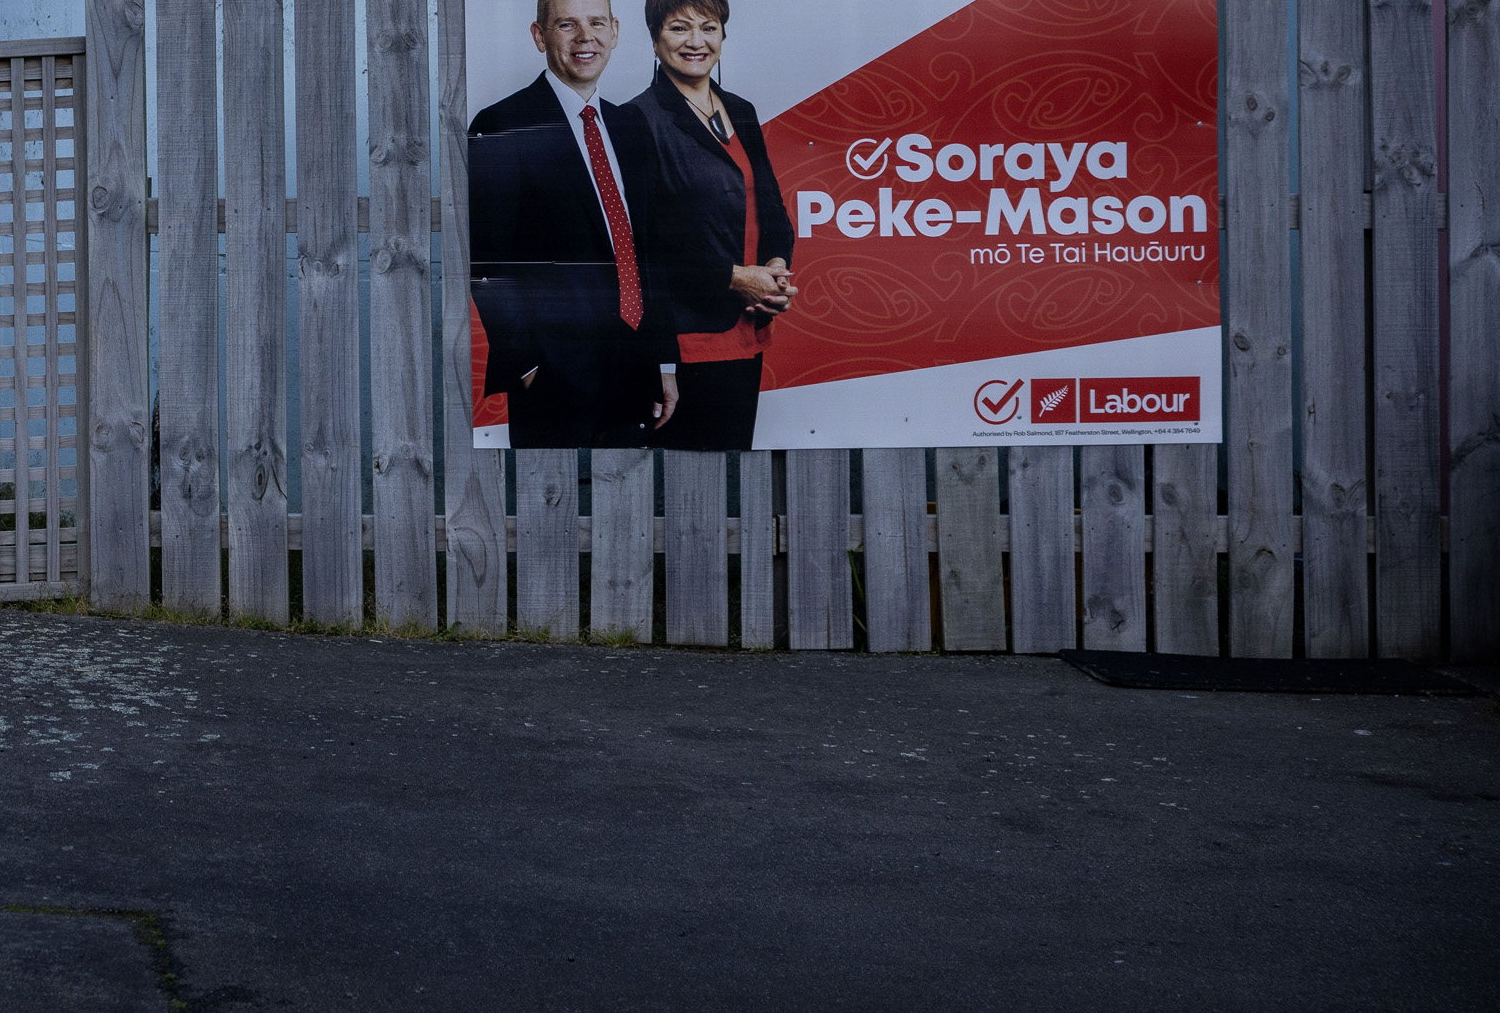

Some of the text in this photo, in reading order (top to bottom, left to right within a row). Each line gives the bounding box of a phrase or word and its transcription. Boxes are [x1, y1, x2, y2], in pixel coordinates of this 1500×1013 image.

[896, 134, 1127, 192] Soraya
[797, 187, 1207, 238] Peke-Mason
[971, 241, 1205, 264] mō Te Tai Hauāuru
[1090, 388, 1190, 413] Labour
